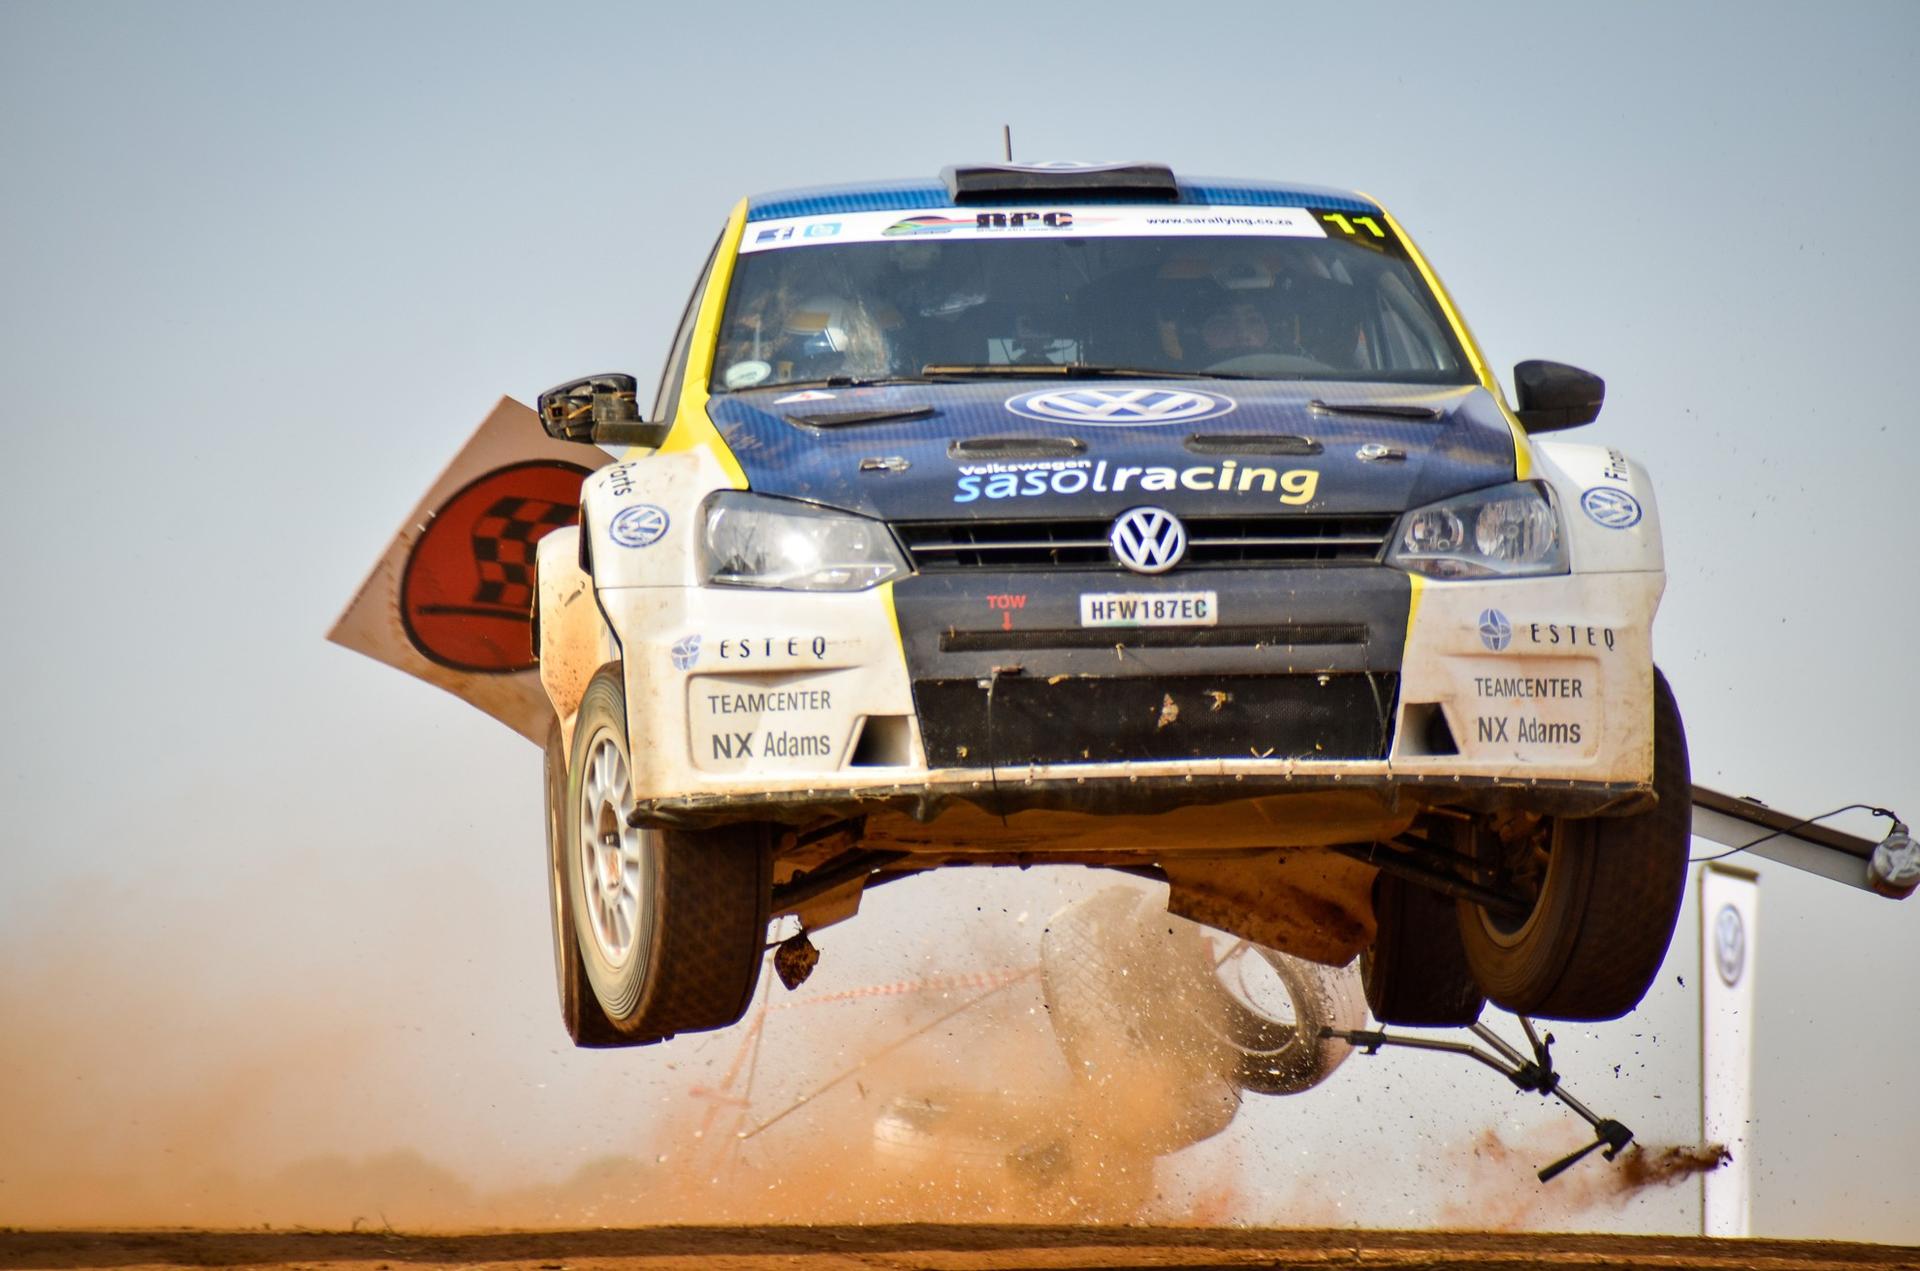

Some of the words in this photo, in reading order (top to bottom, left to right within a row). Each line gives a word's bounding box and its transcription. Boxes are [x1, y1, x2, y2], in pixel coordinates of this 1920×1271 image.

[1323, 213, 1385, 237] 11
[958, 459, 1092, 476] Volkswagen
[986, 595, 1027, 609] TOW
[1091, 599, 1208, 620] HFW187EC
[1474, 677, 1583, 698] TEAMCENTER
[708, 690, 831, 714] TEAMCENTER
[1477, 716, 1509, 743] NX
[1517, 717, 1582, 744] Adams
[711, 732, 754, 760] NX
[763, 730, 831, 758] Adams
